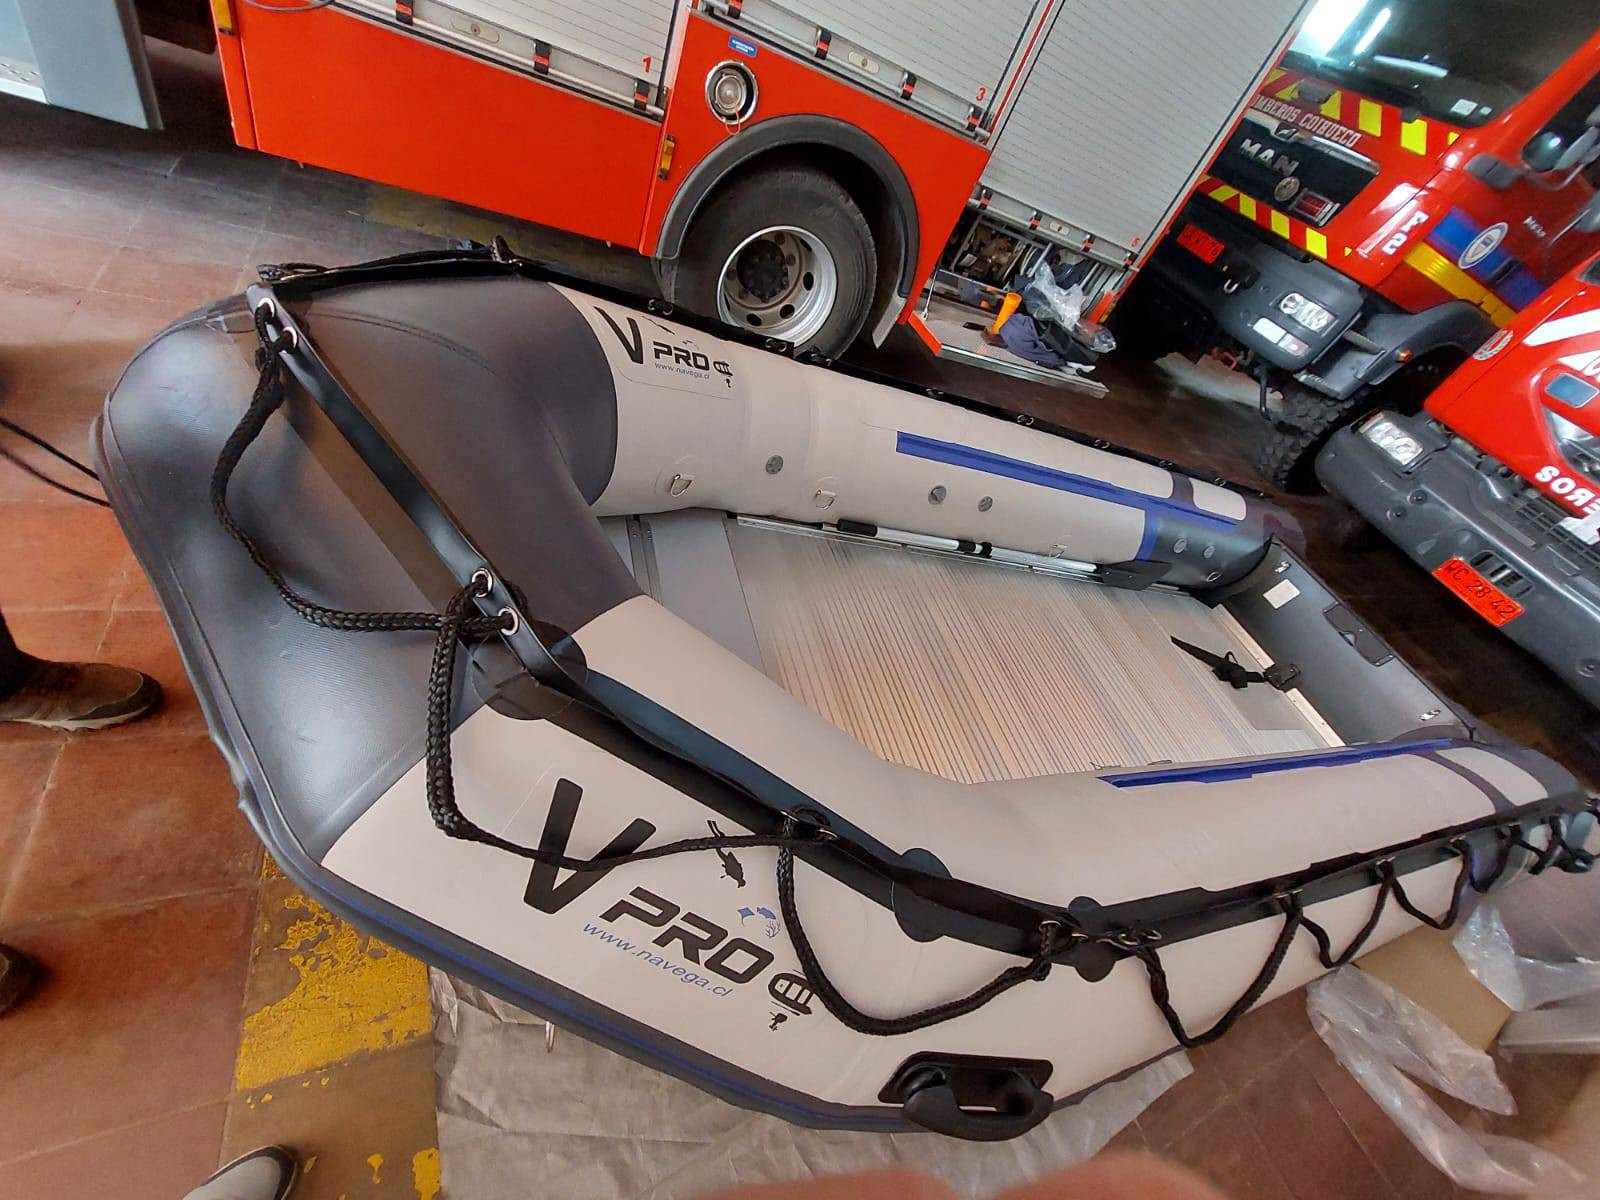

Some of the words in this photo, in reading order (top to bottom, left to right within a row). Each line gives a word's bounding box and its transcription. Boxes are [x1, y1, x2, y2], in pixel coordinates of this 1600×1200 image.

[642, 56, 651, 73] 1
[975, 86, 986, 101] 3
[1253, 95, 1301, 123] MBEROS
[1240, 138, 1299, 177] MAN
[652, 340, 710, 371] PRO
[599, 886, 774, 984] PRO
[583, 921, 734, 998] www.navega.cl
